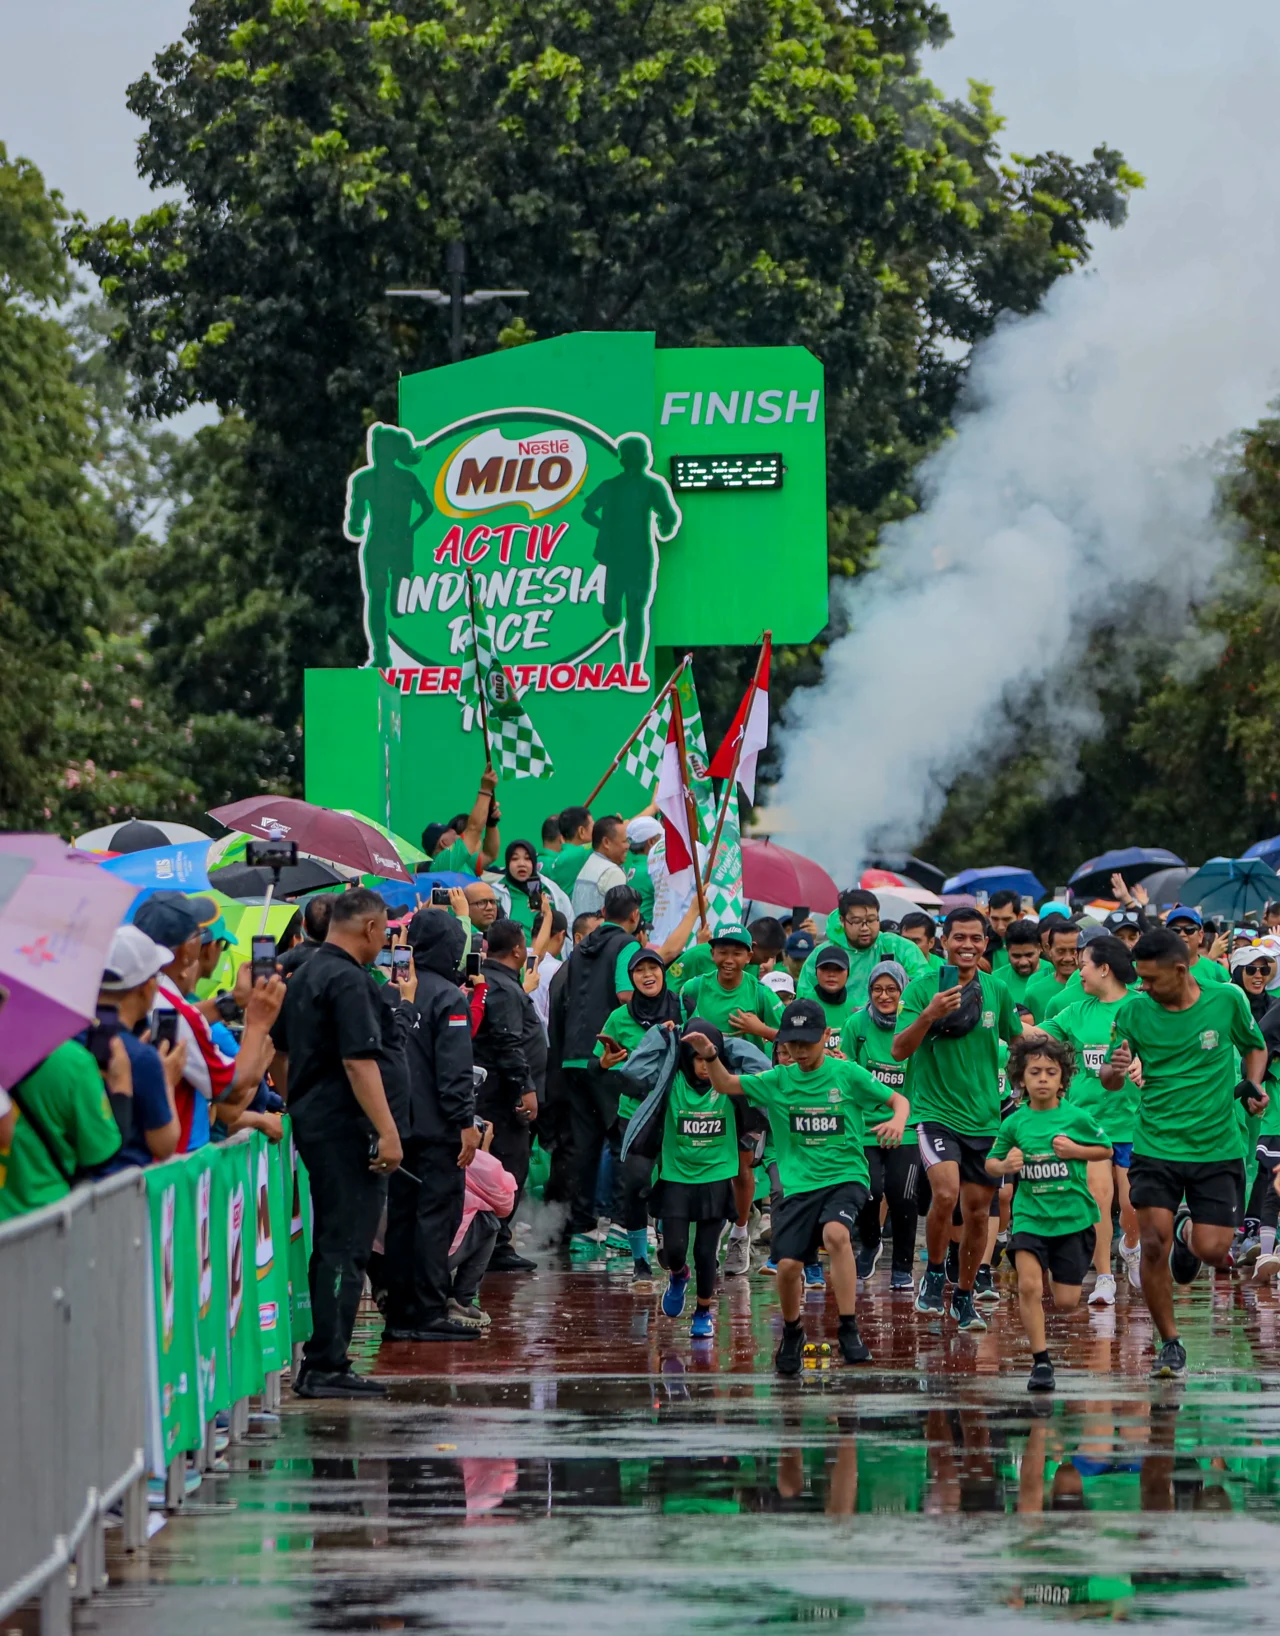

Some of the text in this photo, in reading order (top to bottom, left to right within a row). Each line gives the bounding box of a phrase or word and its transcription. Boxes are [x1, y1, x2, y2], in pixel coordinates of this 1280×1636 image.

[661, 389, 820, 425] FINISH
[456, 456, 573, 496] MILO
[434, 522, 569, 567] ACTIV
[1085, 1053, 1105, 1066] V50
[683, 1119, 722, 1134] K0272
[795, 1116, 838, 1132] K1884
[933, 1138, 946, 1152] 2
[1019, 1162, 1069, 1179] VK0003
